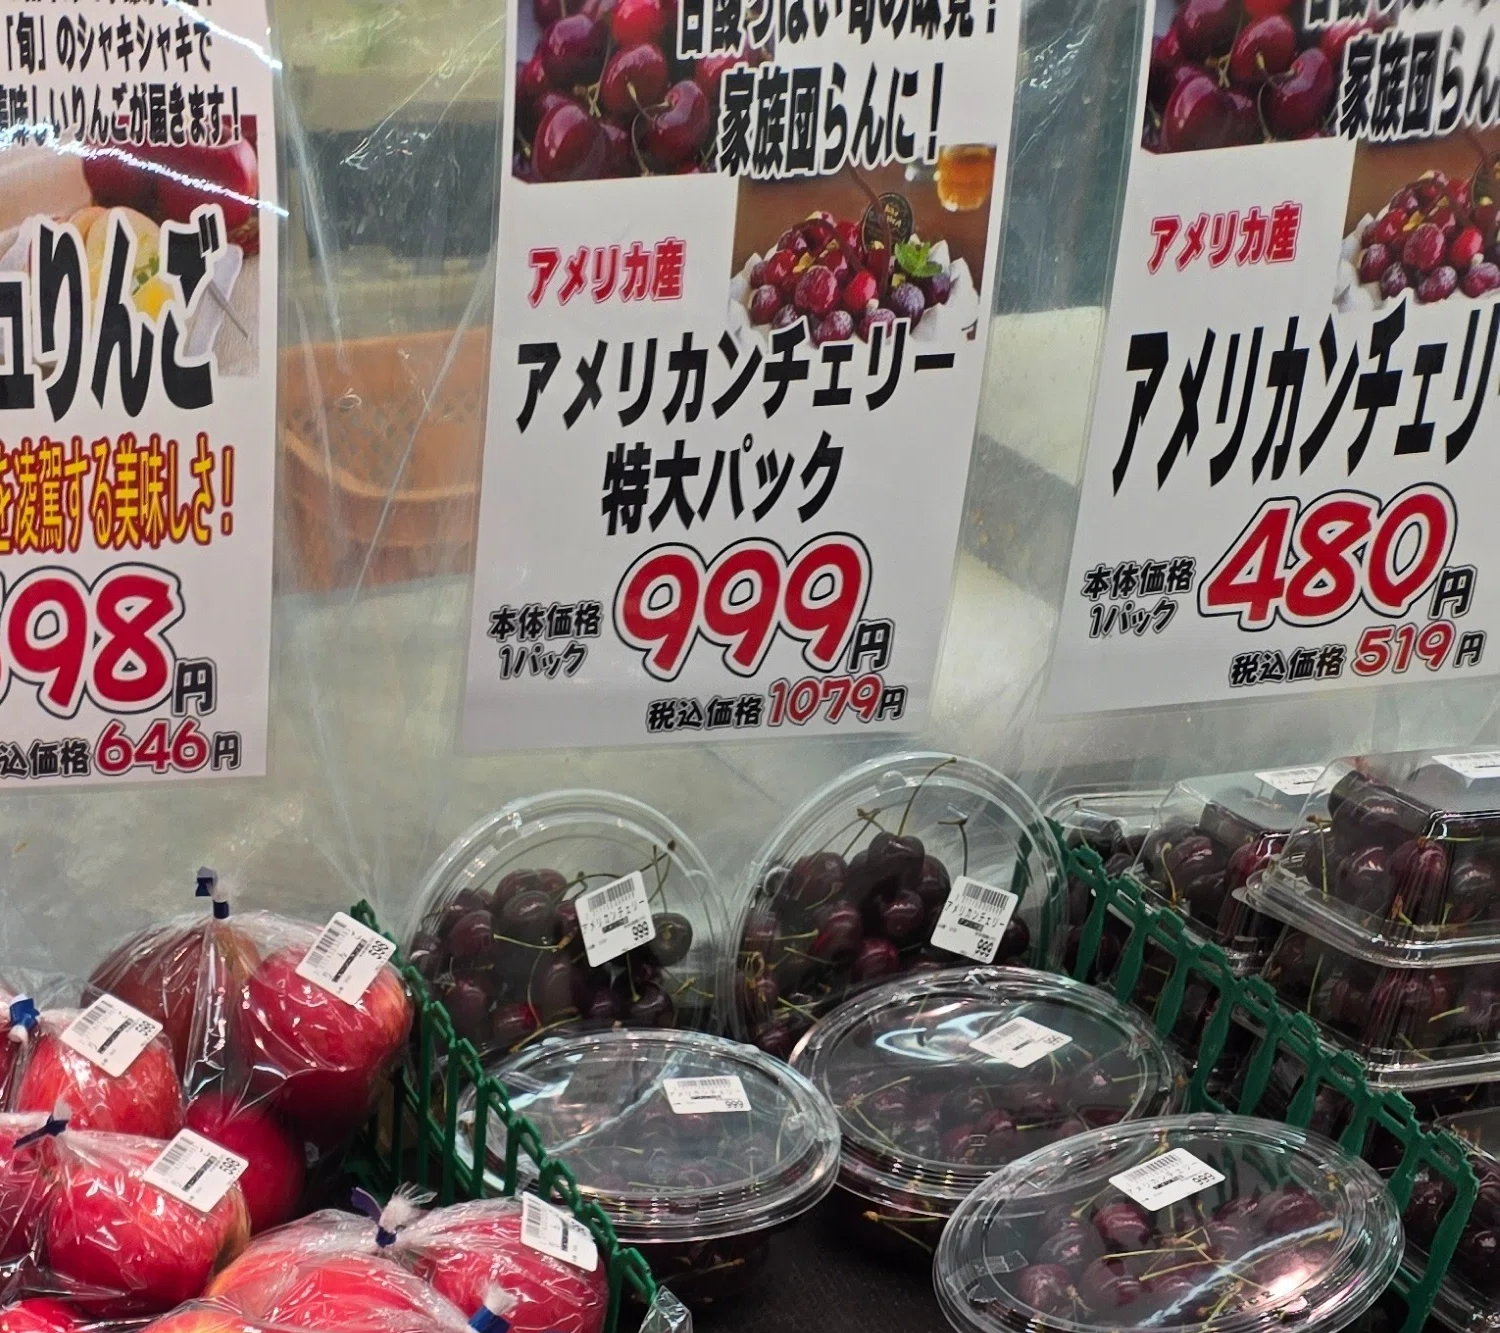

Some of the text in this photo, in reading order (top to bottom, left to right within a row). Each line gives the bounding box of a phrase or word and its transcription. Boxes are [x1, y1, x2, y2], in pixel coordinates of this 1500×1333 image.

[718, 62, 944, 181] 家族団らんに！
[528, 236, 687, 308] アメリカ産
[1148, 201, 1302, 275] アメリカ産
[516, 321, 956, 433] アメリカンチェリー
[1113, 304, 1500, 497] アメリカンチェリ
[602, 431, 844, 536] 特大パック
[1082, 557, 1197, 599] 本体価格
[1197, 482, 1478, 631] 480円
[488, 601, 604, 642] 本体価格
[612, 531, 896, 682] 999円
[1088, 599, 1179, 638] 1パック
[500, 643, 588, 680] 1パック
[631, 921, 649, 941] 999
